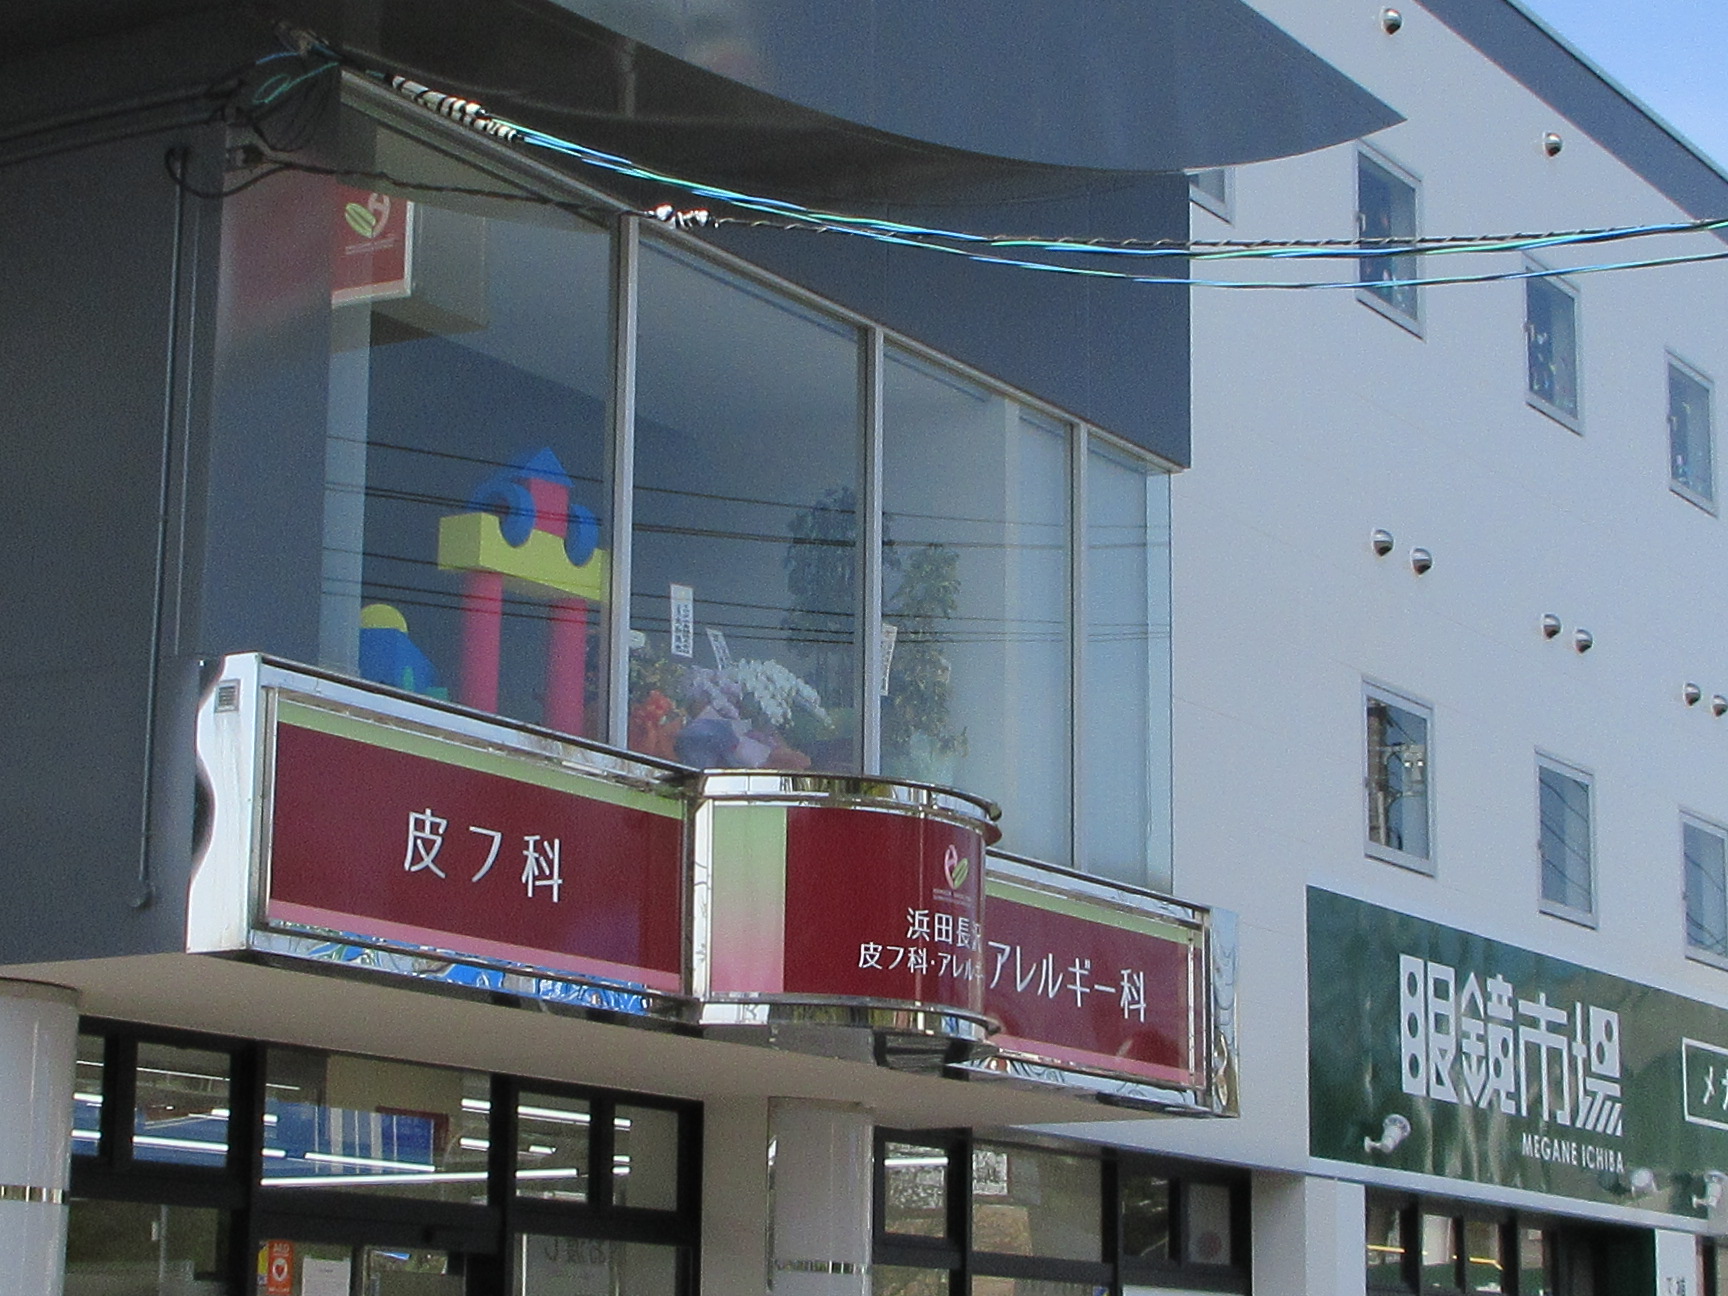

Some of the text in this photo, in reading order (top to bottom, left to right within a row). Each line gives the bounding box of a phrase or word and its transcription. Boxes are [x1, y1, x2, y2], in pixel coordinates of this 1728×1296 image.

[403, 806, 564, 903] 皮フ科
[988, 940, 1146, 1023] アレルギー科
[1399, 954, 1622, 1136] 眼鏡市場
[1521, 1133, 1624, 1174] MEGANE ICHIBA
